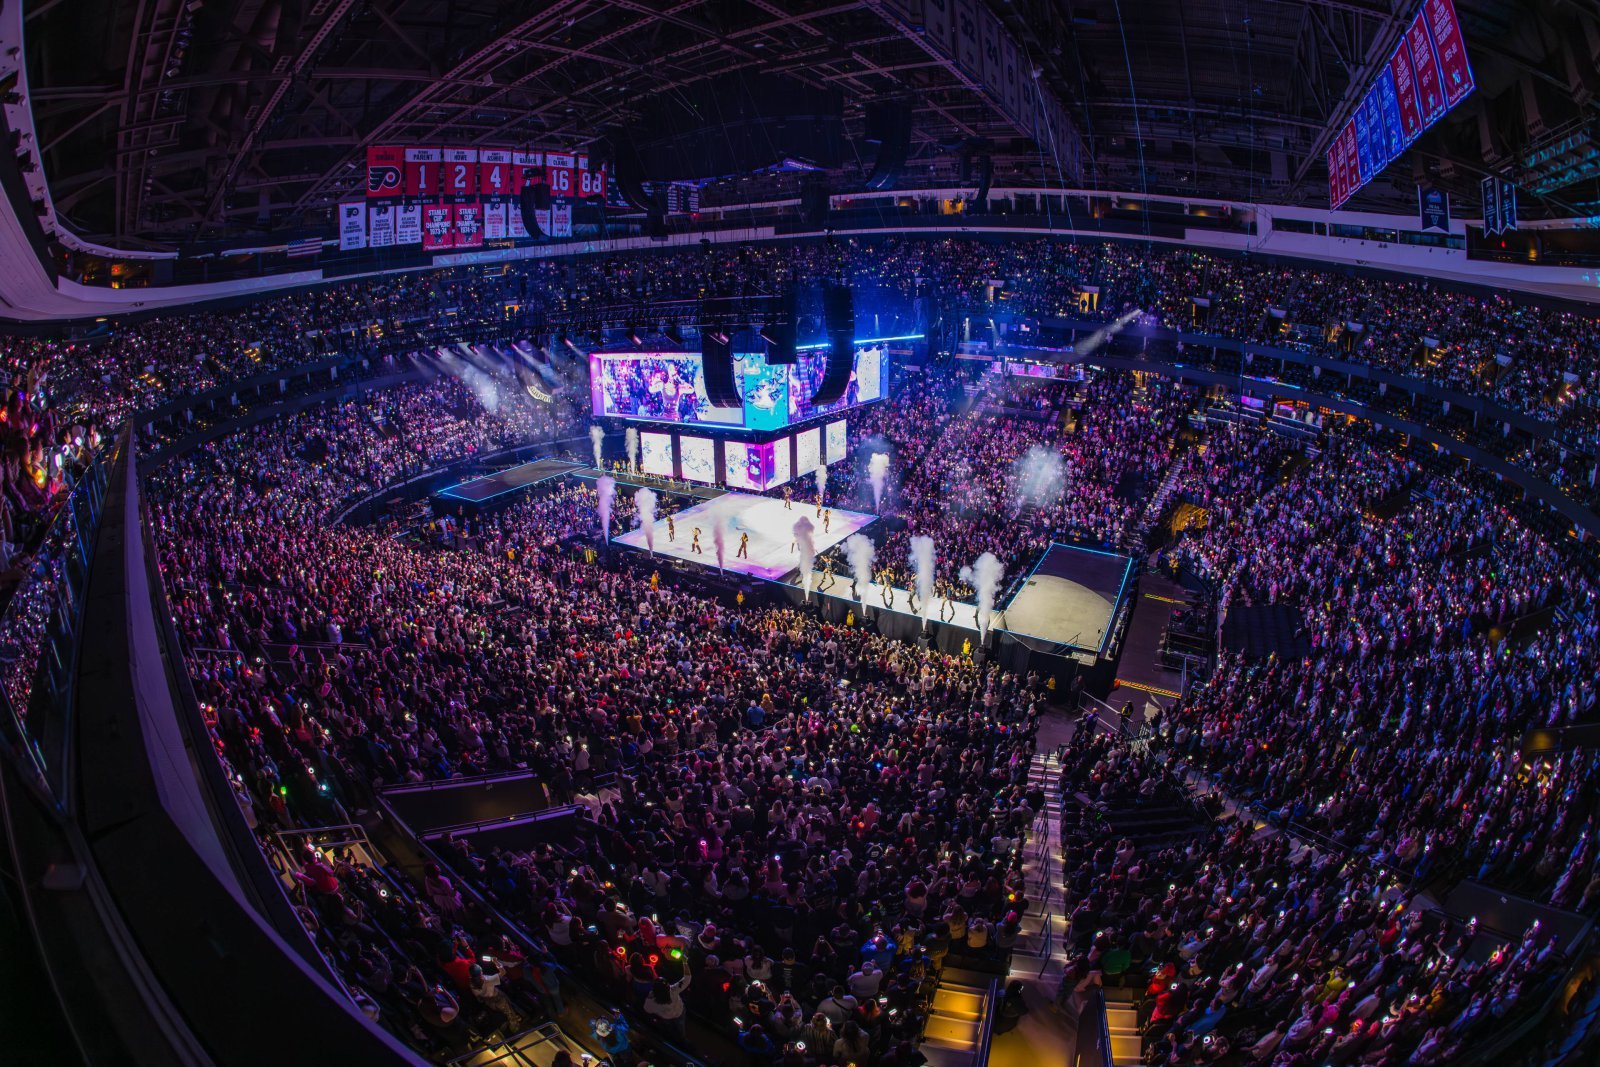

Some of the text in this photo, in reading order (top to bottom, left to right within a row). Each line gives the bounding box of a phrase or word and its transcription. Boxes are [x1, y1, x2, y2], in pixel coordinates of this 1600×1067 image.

[419, 164, 427, 189] 1
[454, 164, 466, 188] 2
[490, 165, 502, 188] 4
[552, 169, 569, 191] 16
[581, 172, 602, 193] 88
[428, 209, 448, 217] STANLEY
[425, 221, 451, 229] CHAMPIONS
